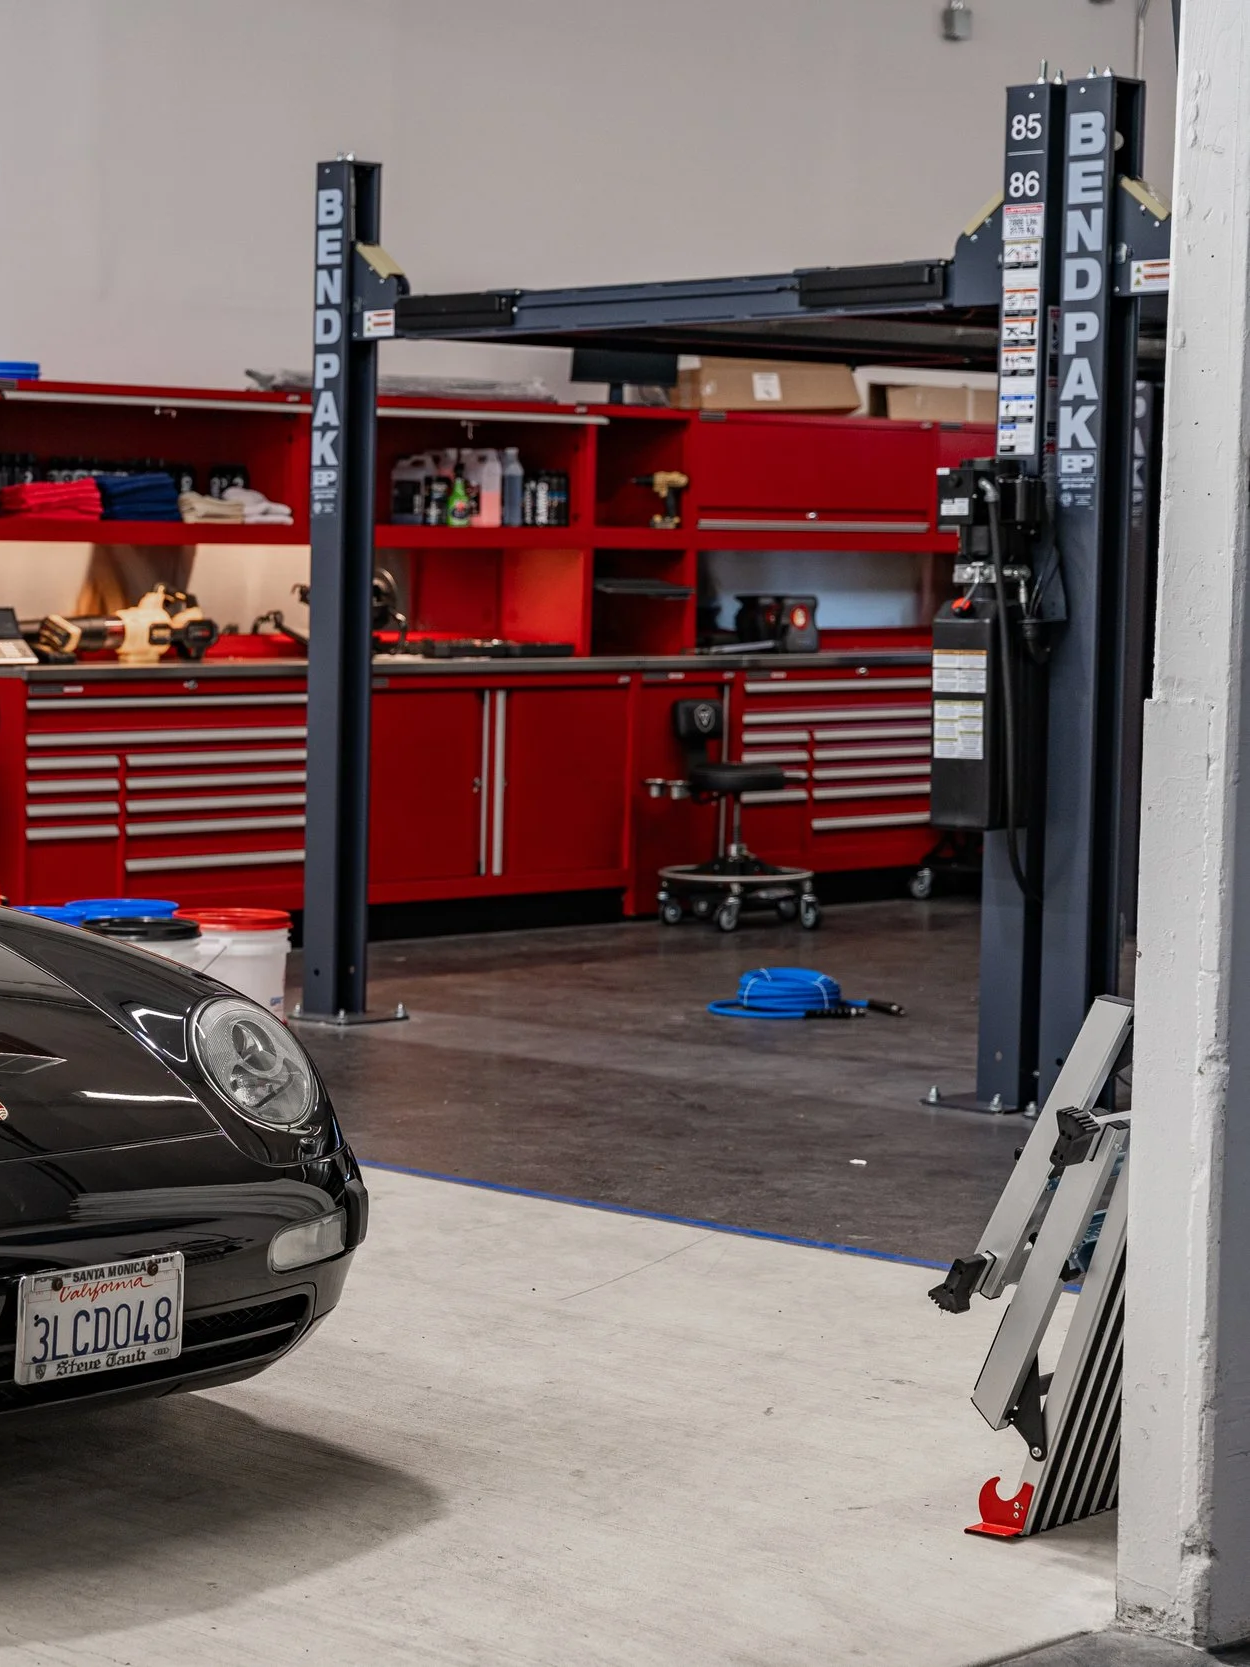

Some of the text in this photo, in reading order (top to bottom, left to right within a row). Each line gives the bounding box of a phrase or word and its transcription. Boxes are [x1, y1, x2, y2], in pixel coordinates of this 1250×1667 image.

[1011, 113, 1042, 141] 85
[1009, 171, 1040, 198] 86
[1057, 110, 1107, 450] BENDPAK
[311, 187, 344, 467] BENDPAK
[1061, 454, 1095, 474] BP
[312, 469, 338, 488] BP
[72, 1266, 105, 1283] SANTA
[107, 1260, 147, 1277] MONICA
[59, 1275, 153, 1304] California
[31, 1296, 172, 1364] 3LCD048
[55, 1347, 146, 1377] Steve Taub
